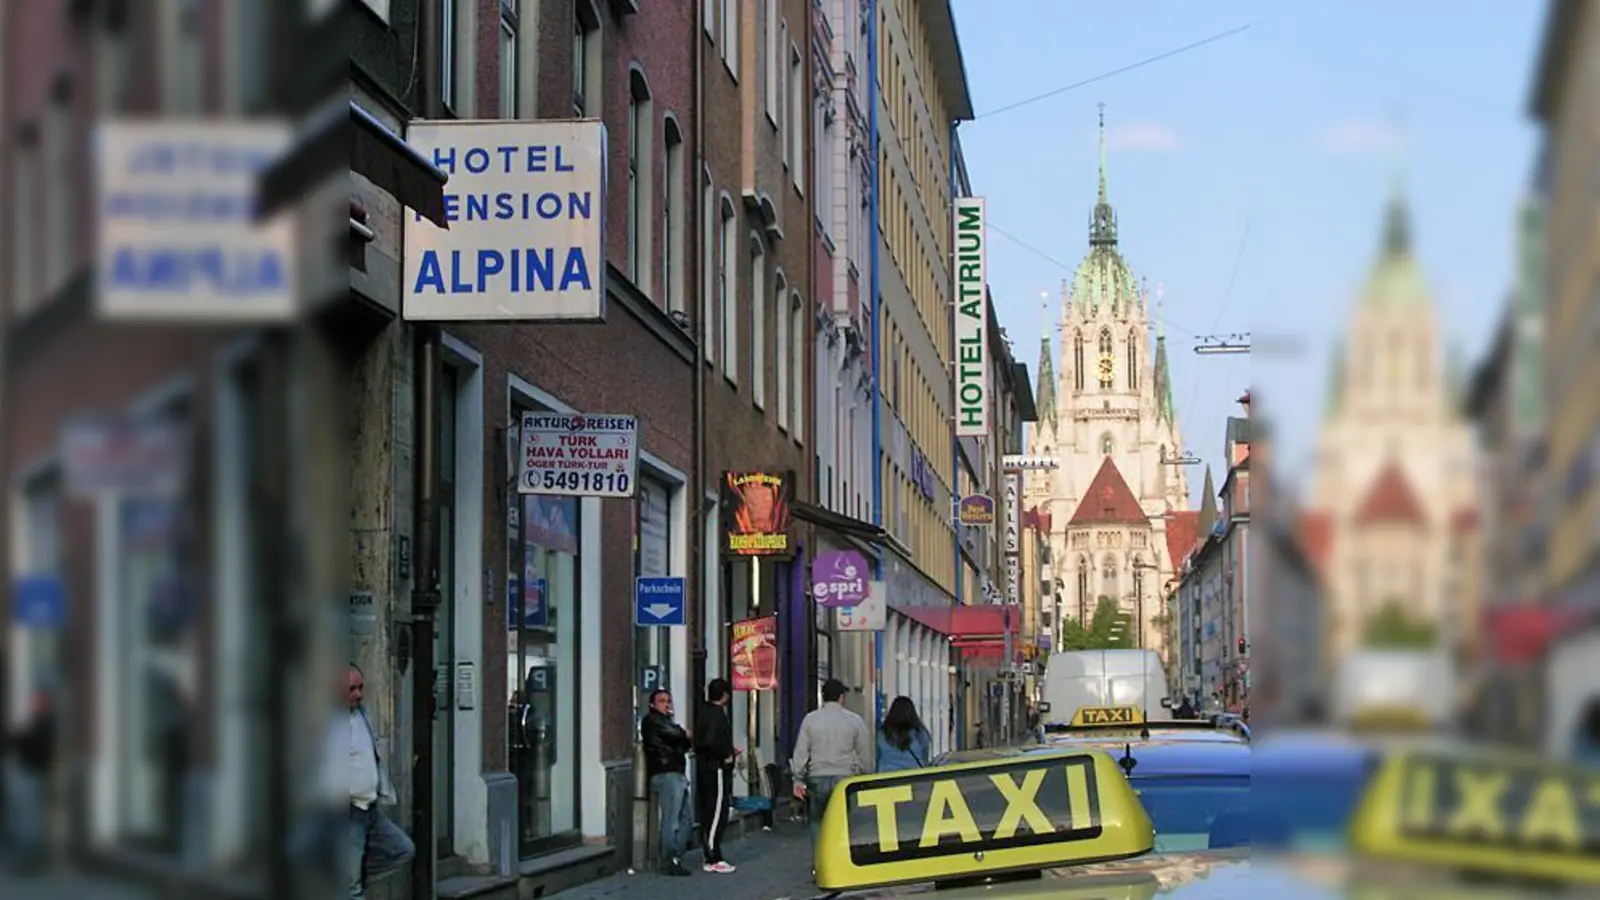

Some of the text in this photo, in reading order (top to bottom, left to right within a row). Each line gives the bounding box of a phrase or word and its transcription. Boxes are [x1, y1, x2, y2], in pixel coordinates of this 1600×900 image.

[431, 145, 574, 173] HOTEL
[415, 191, 592, 222] ENSION
[413, 247, 592, 293] ALPINA
[958, 205, 983, 427] HOTEL ATRIUM
[524, 416, 635, 430] AKTUR REISEN
[526, 447, 629, 460] HAVA YOLLARI
[543, 470, 629, 493] 5491810
[1005, 486, 1016, 549] ATLAS
[640, 582, 681, 594] Parkschein
[813, 578, 862, 600] espri
[645, 669, 657, 689] P
[1085, 709, 1131, 723] TAXI
[857, 763, 1095, 854] TAXI
